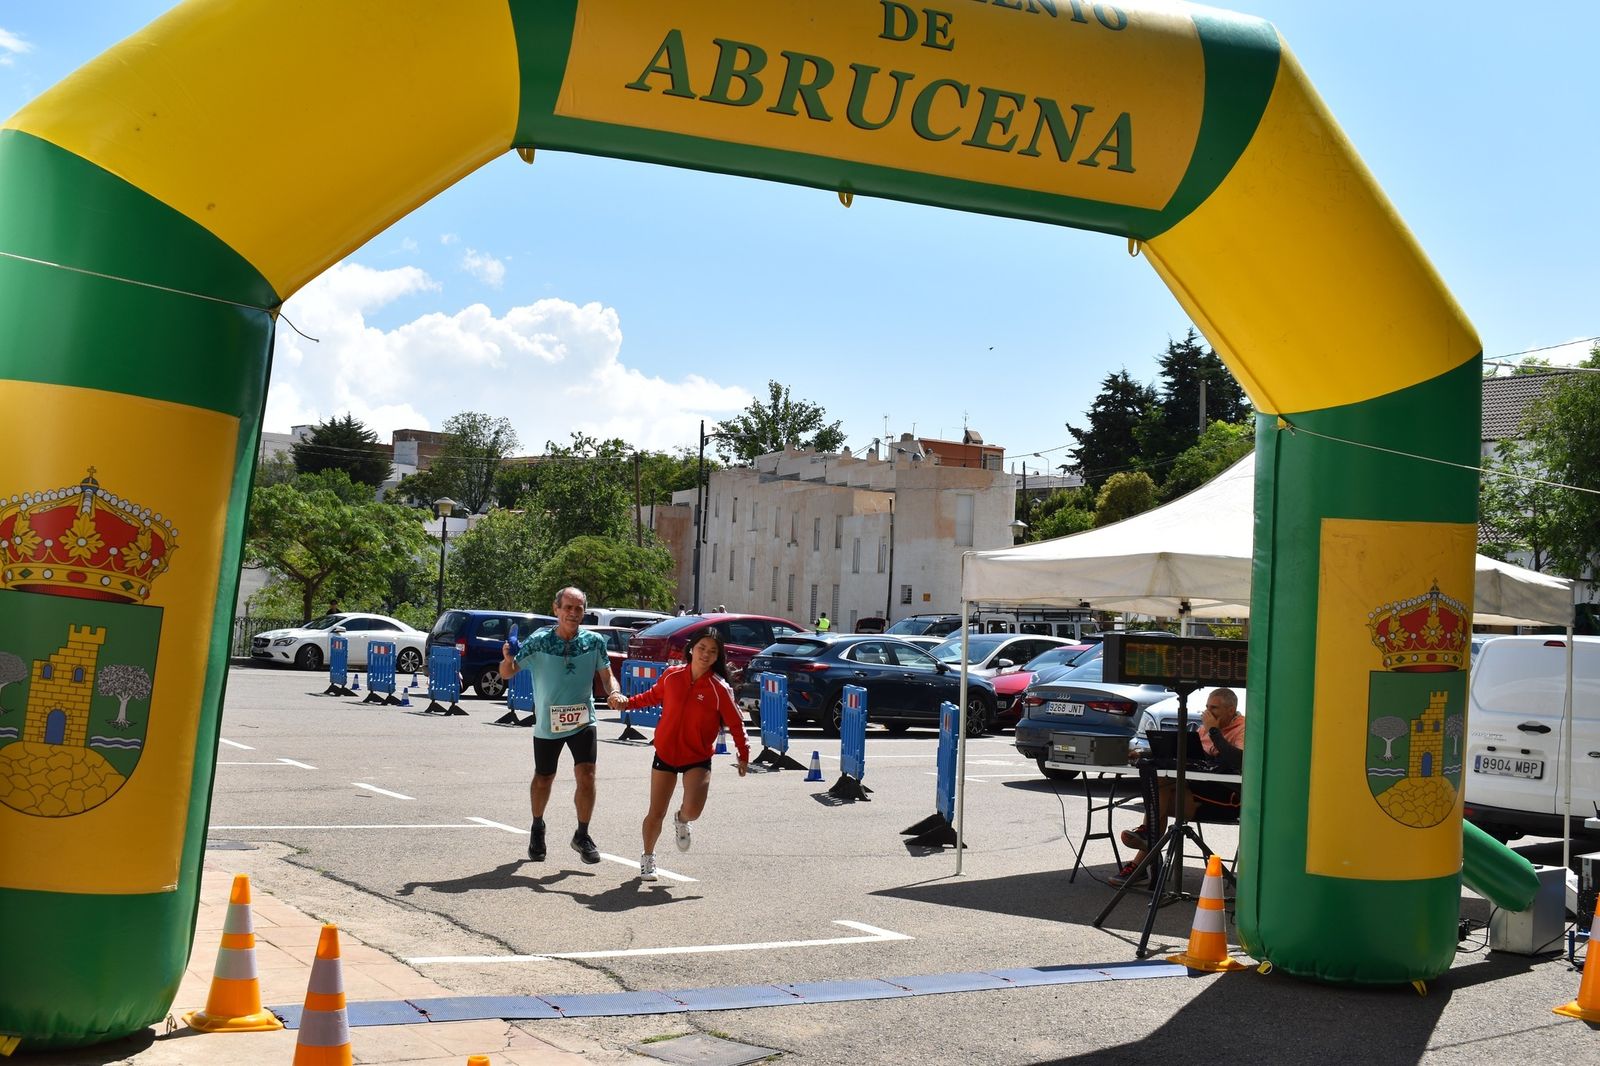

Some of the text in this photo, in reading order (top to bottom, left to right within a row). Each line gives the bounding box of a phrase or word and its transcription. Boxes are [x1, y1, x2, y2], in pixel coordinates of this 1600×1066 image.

[879, 0, 955, 51] DE
[625, 29, 1136, 174] ABRUCENA
[1050, 703, 1082, 714] 9268 JNT
[559, 712, 581, 723] 507
[1482, 757, 1511, 771] 8904
[1515, 761, 1538, 774] MBP
